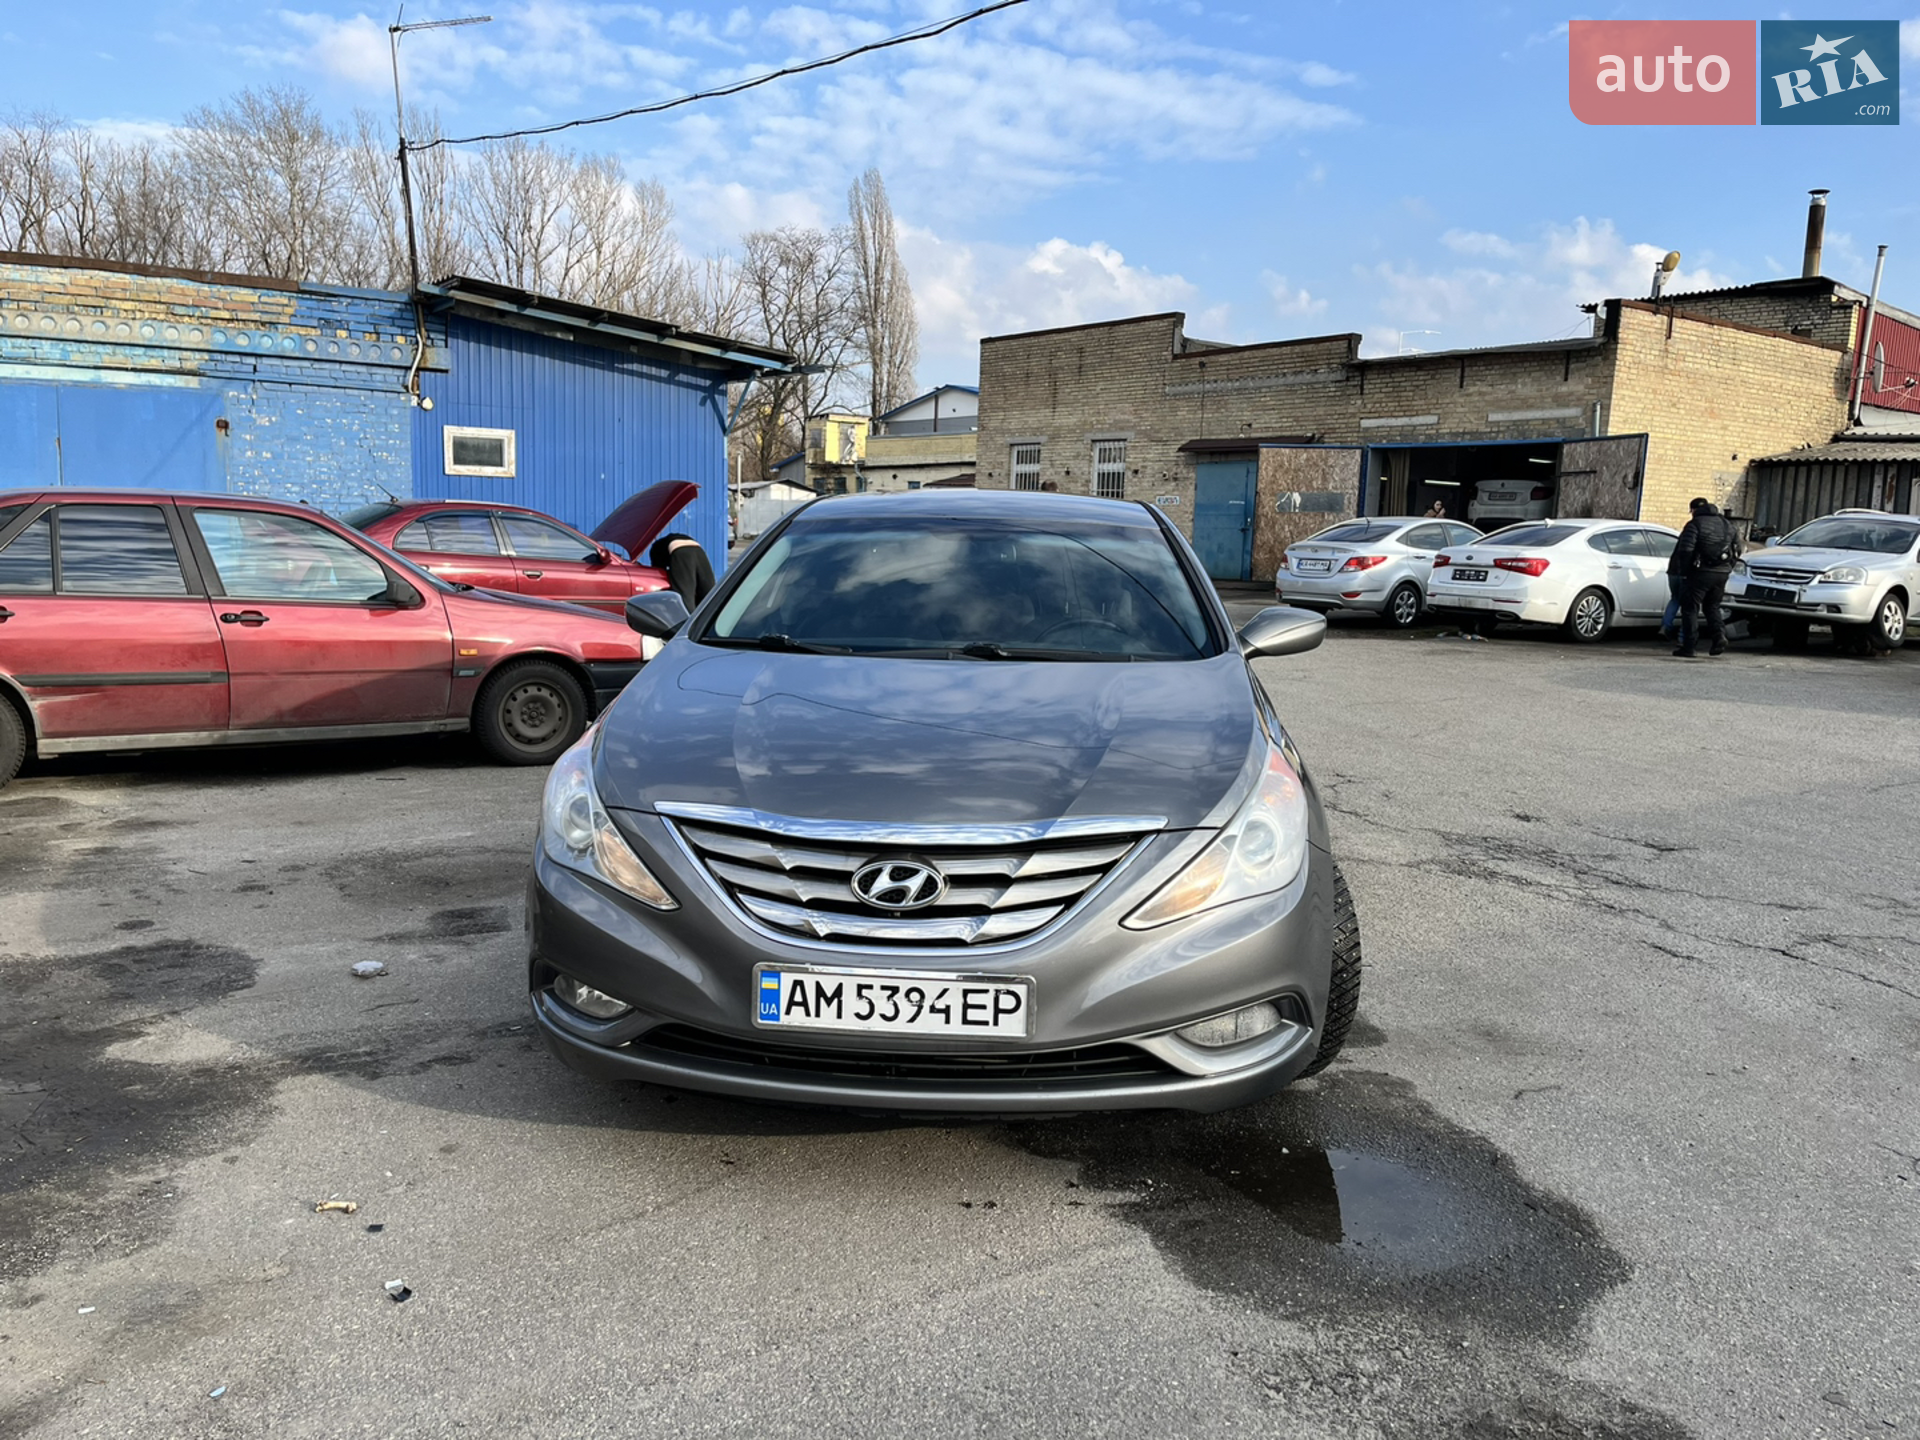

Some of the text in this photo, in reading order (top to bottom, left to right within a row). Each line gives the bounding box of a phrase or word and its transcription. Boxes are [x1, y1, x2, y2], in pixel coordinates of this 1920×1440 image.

[760, 1002, 778, 1016] UA
[784, 978, 1022, 1027] AM 5394 EP
